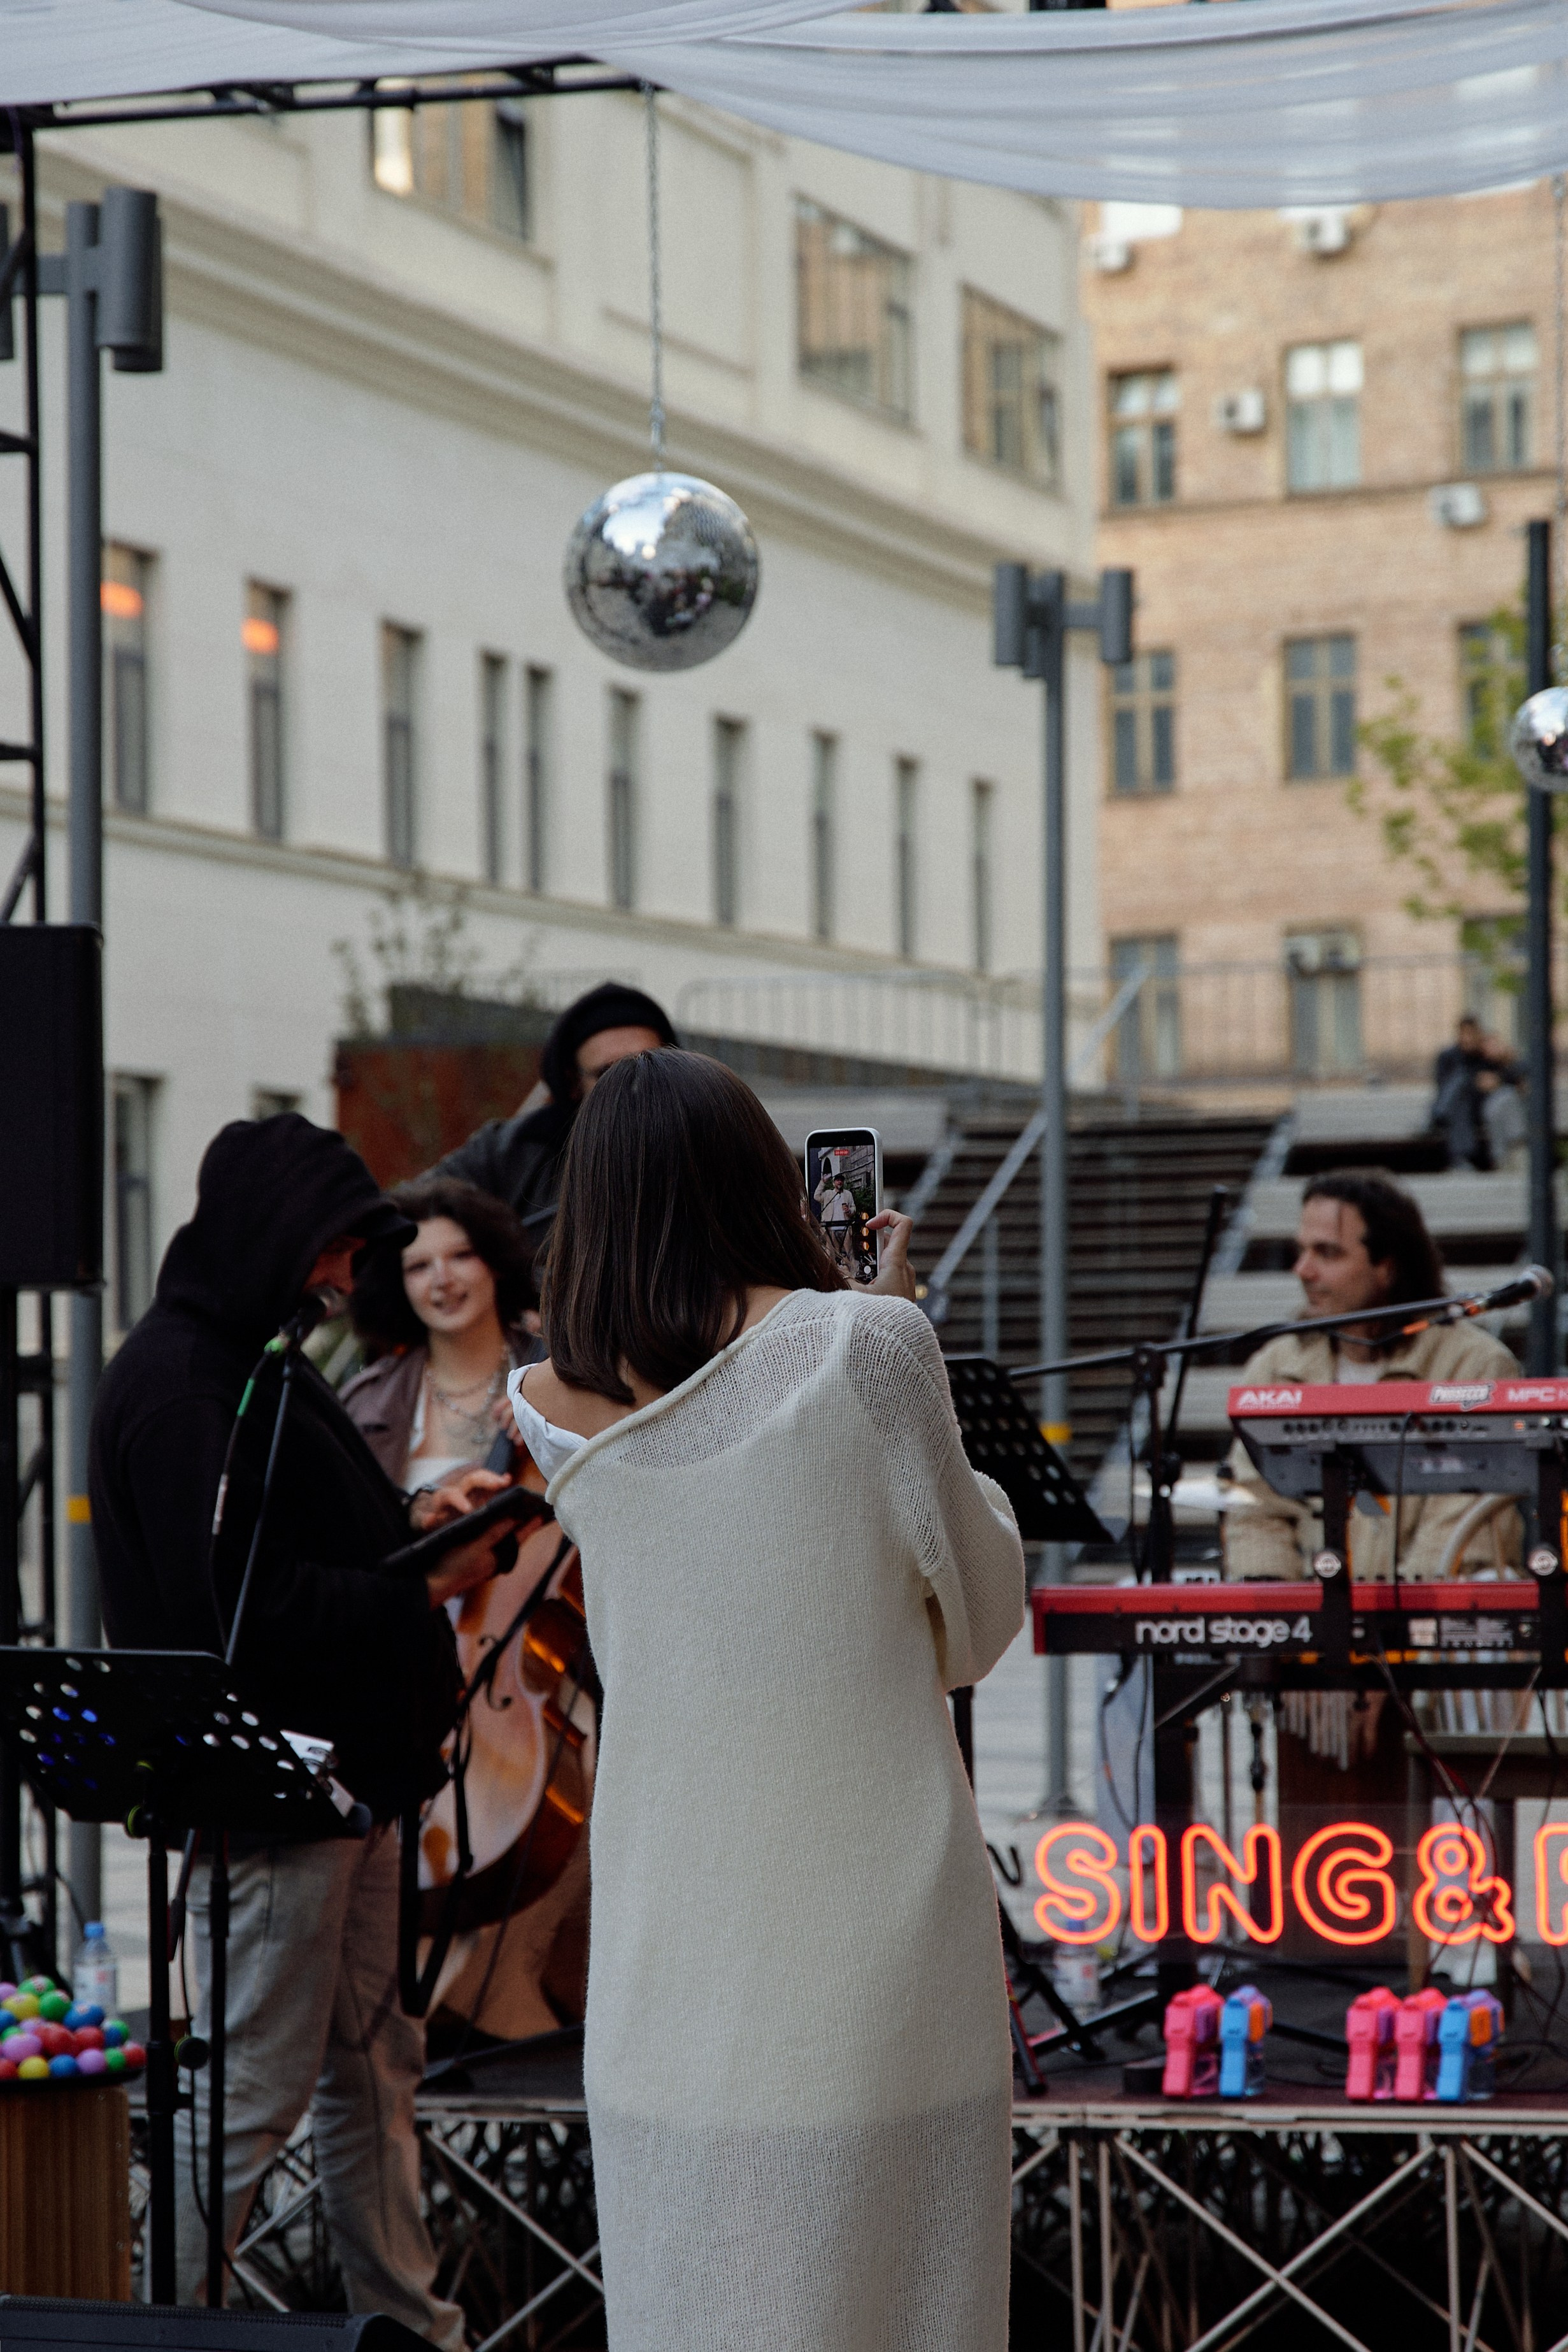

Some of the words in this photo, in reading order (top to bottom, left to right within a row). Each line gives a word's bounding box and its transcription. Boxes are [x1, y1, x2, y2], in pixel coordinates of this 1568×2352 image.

[1237, 1389, 1302, 1405] AKAI
[1507, 1386, 1556, 1402] MPC
[1135, 1616, 1206, 1644] nord
[1209, 1616, 1291, 1648] stage
[1291, 1615, 1313, 1643] 4
